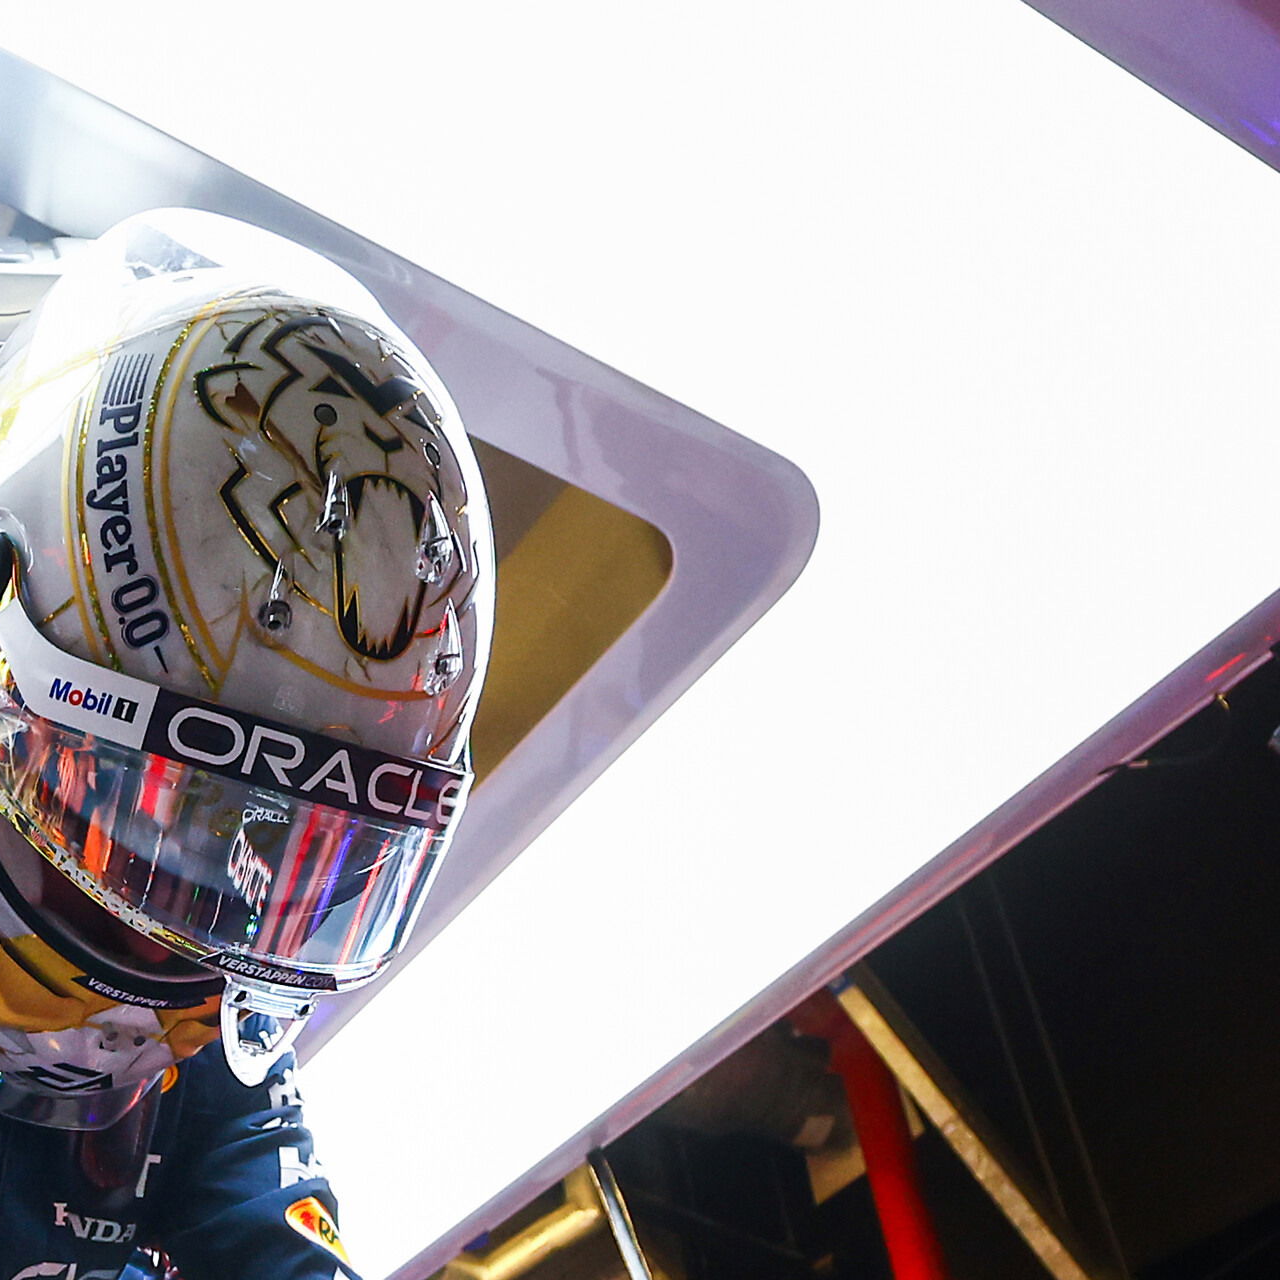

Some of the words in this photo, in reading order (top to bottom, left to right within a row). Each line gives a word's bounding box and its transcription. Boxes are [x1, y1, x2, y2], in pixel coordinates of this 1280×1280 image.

[85, 393, 141, 579] Player
[49, 677, 111, 716] Mobil
[167, 707, 464, 826] ORACLE
